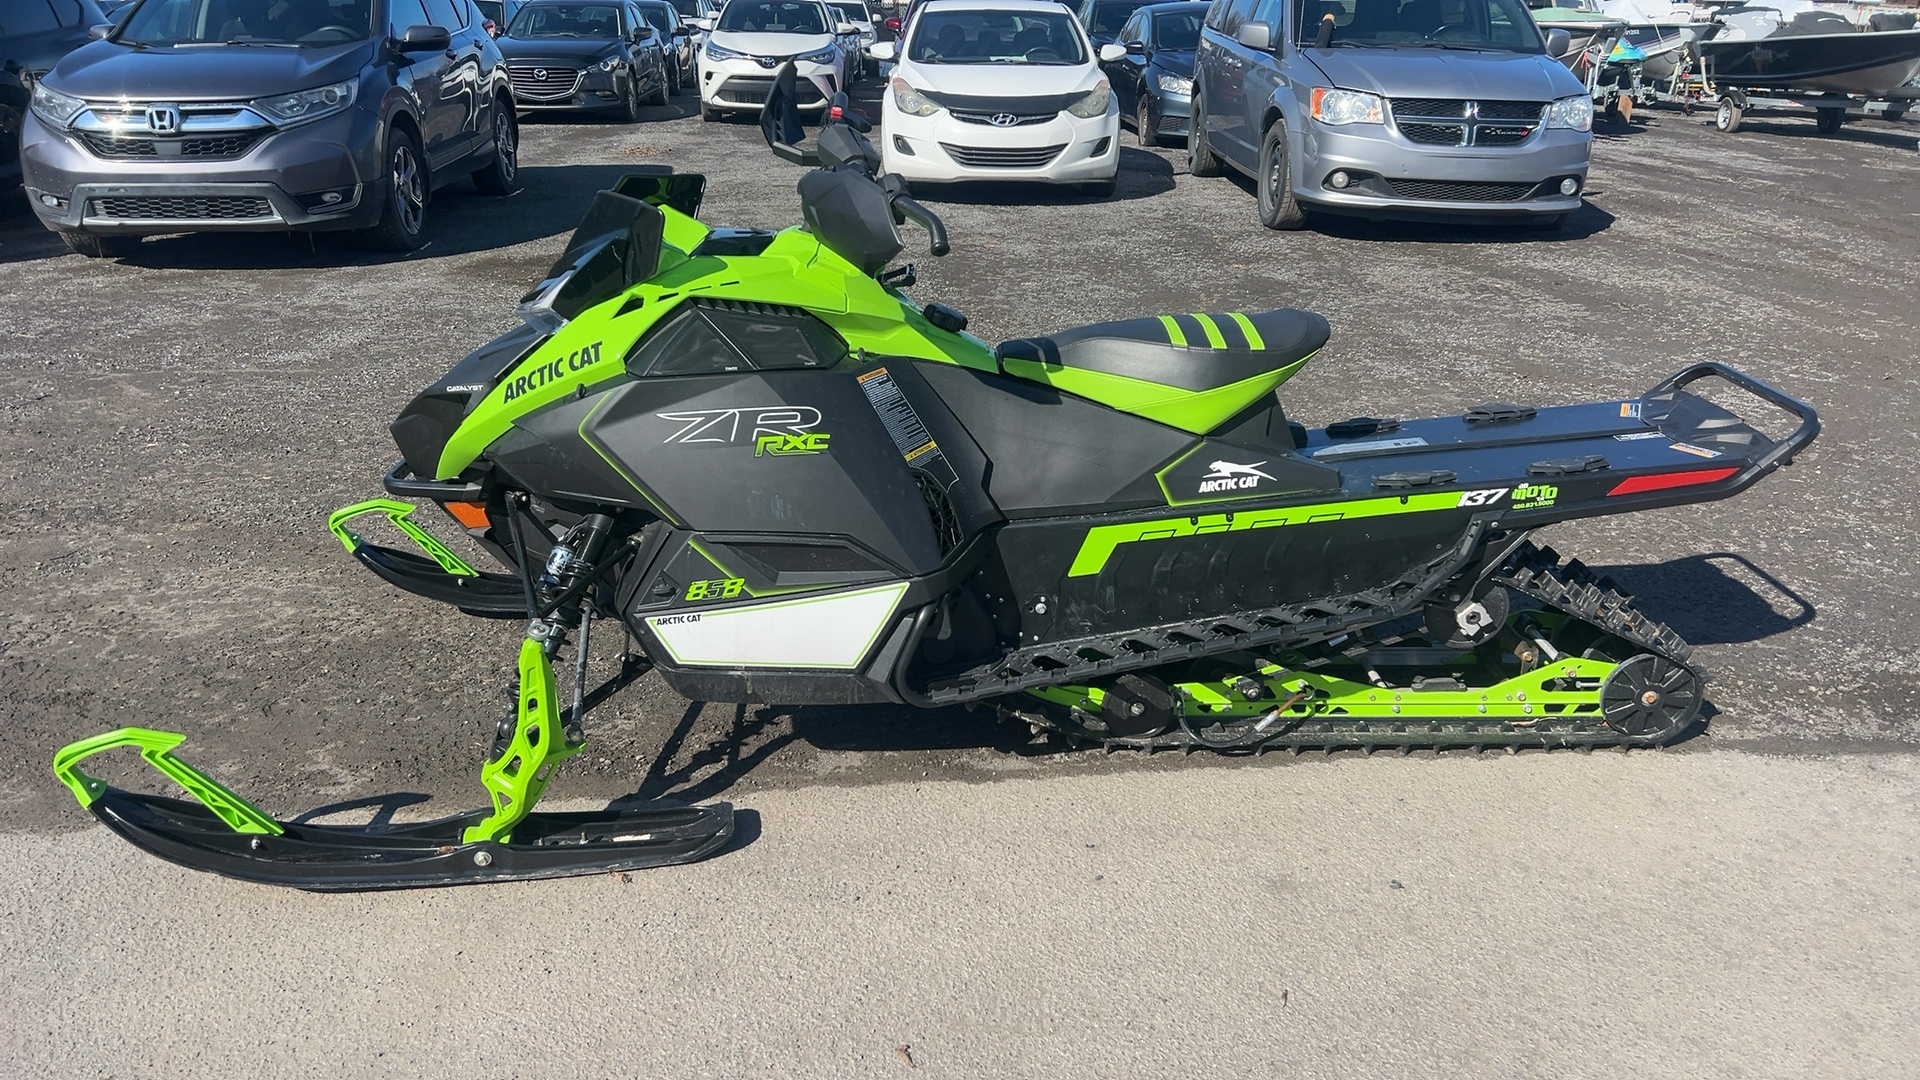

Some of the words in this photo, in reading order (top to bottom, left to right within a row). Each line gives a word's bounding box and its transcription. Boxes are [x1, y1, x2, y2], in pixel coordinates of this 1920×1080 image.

[503, 357, 564, 405] ARCTIC
[568, 341, 603, 371] CAT
[446, 384, 484, 392] CATALYST
[655, 405, 822, 444] ZR
[754, 433, 831, 458] RXC
[1198, 478, 1238, 493] ARCTIC
[1239, 475, 1260, 489] CAT
[1457, 488, 1510, 507] 137
[685, 577, 745, 601] 858
[656, 615, 685, 626] ARCTIC
[686, 614, 702, 623] CAT
